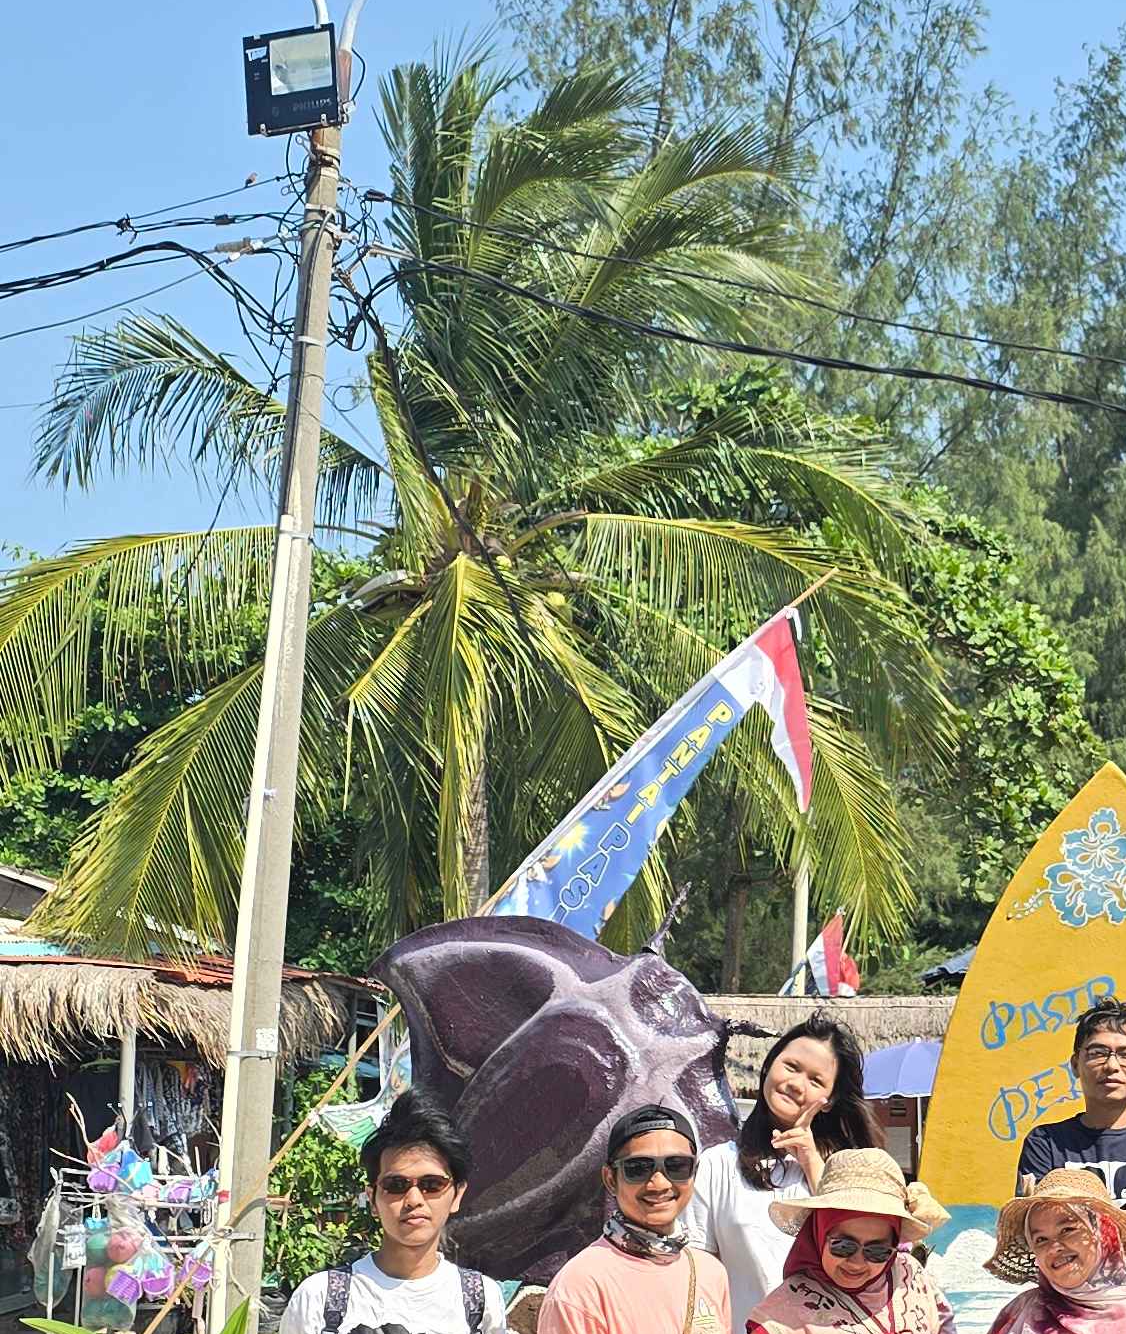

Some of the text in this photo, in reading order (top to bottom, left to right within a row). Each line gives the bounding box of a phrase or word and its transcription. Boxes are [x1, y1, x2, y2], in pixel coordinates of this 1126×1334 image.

[292, 98, 333, 113] PHILIPS
[551, 701, 734, 924] PANTAI PASI
